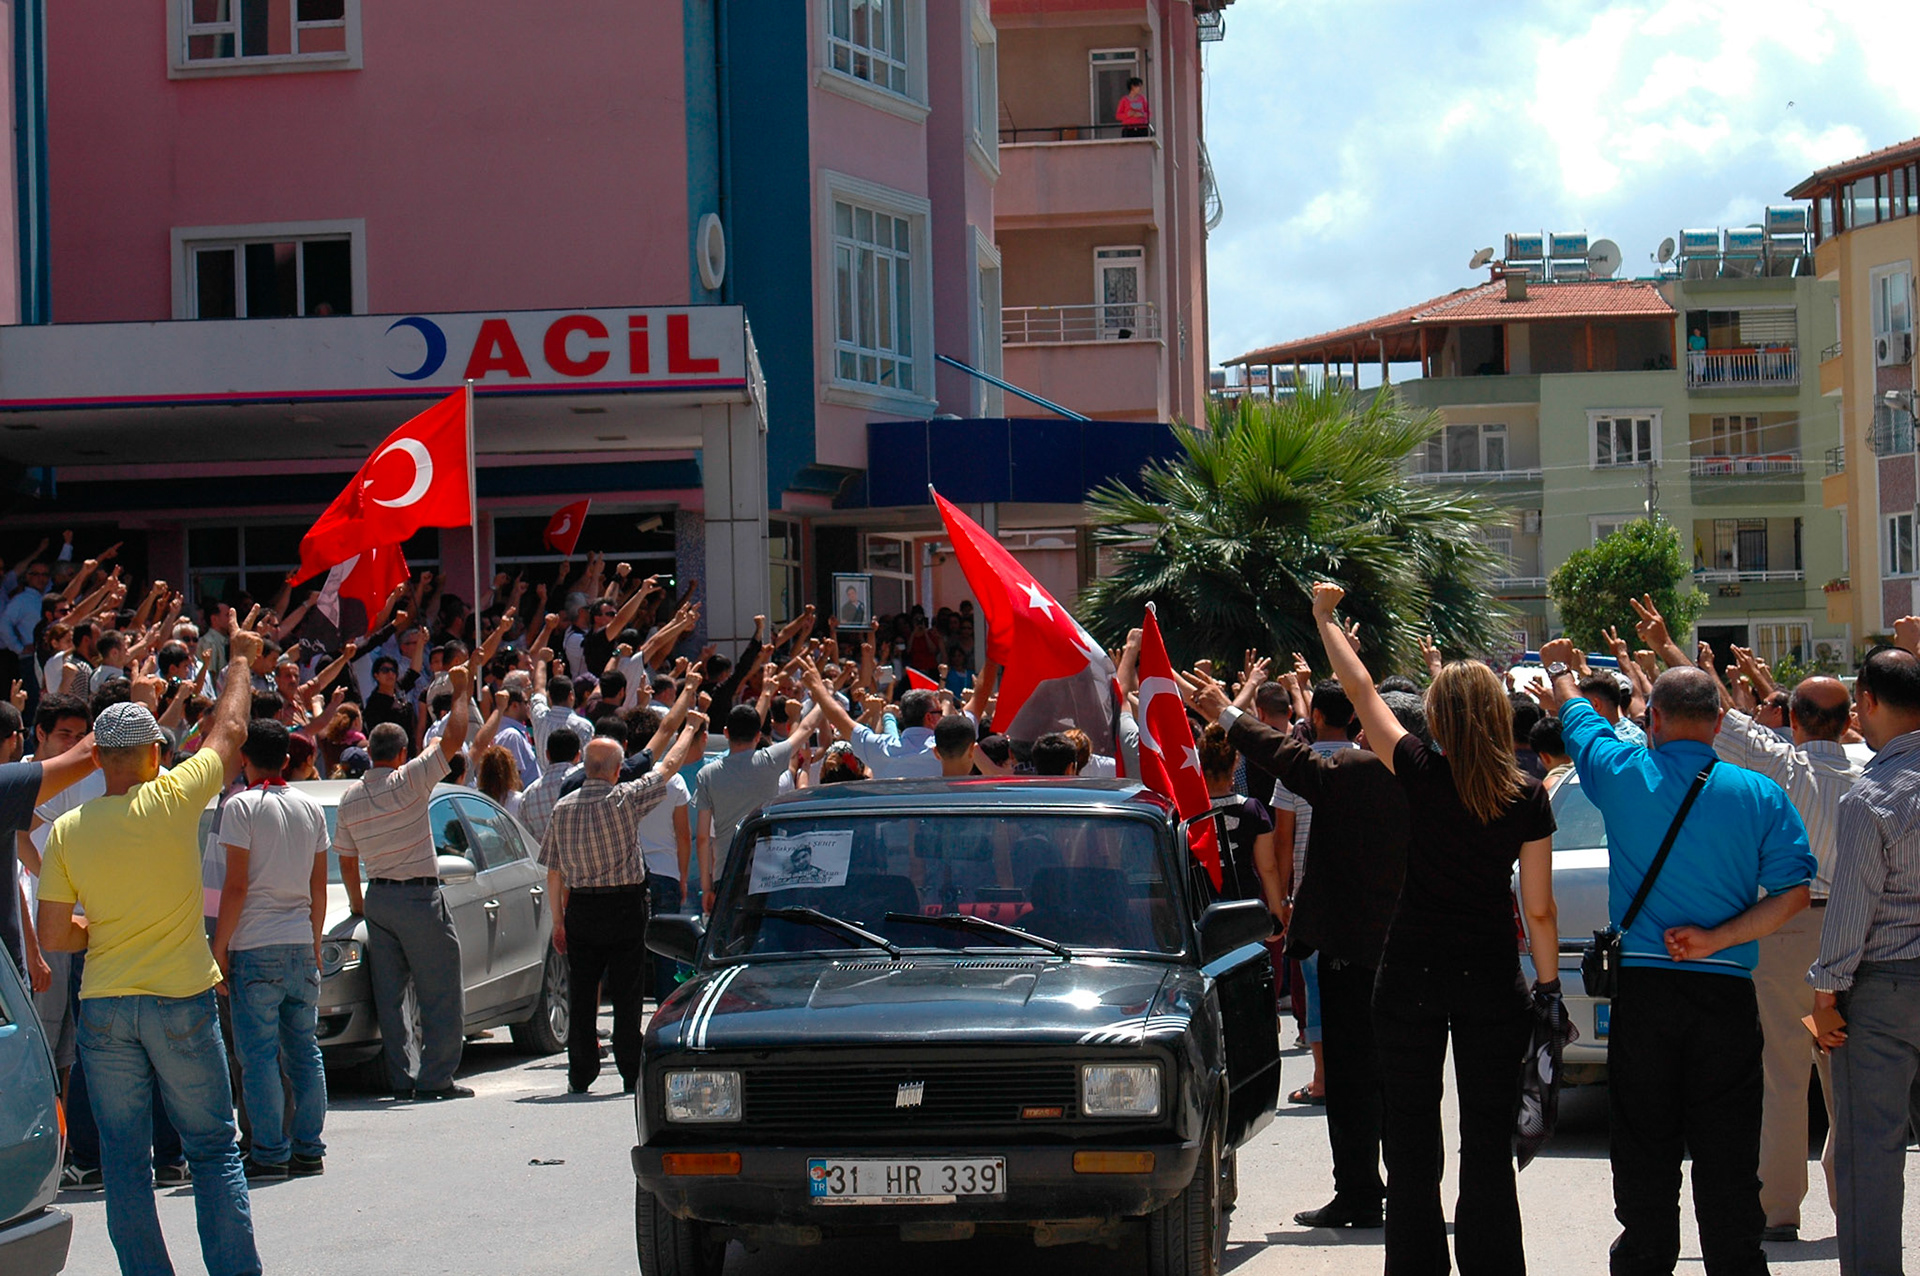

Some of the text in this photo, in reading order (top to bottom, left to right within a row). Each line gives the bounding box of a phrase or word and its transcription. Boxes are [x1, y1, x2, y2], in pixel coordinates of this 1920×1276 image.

[814, 1183, 826, 1191] TR
[830, 1165, 996, 1194] 31 HR 339
